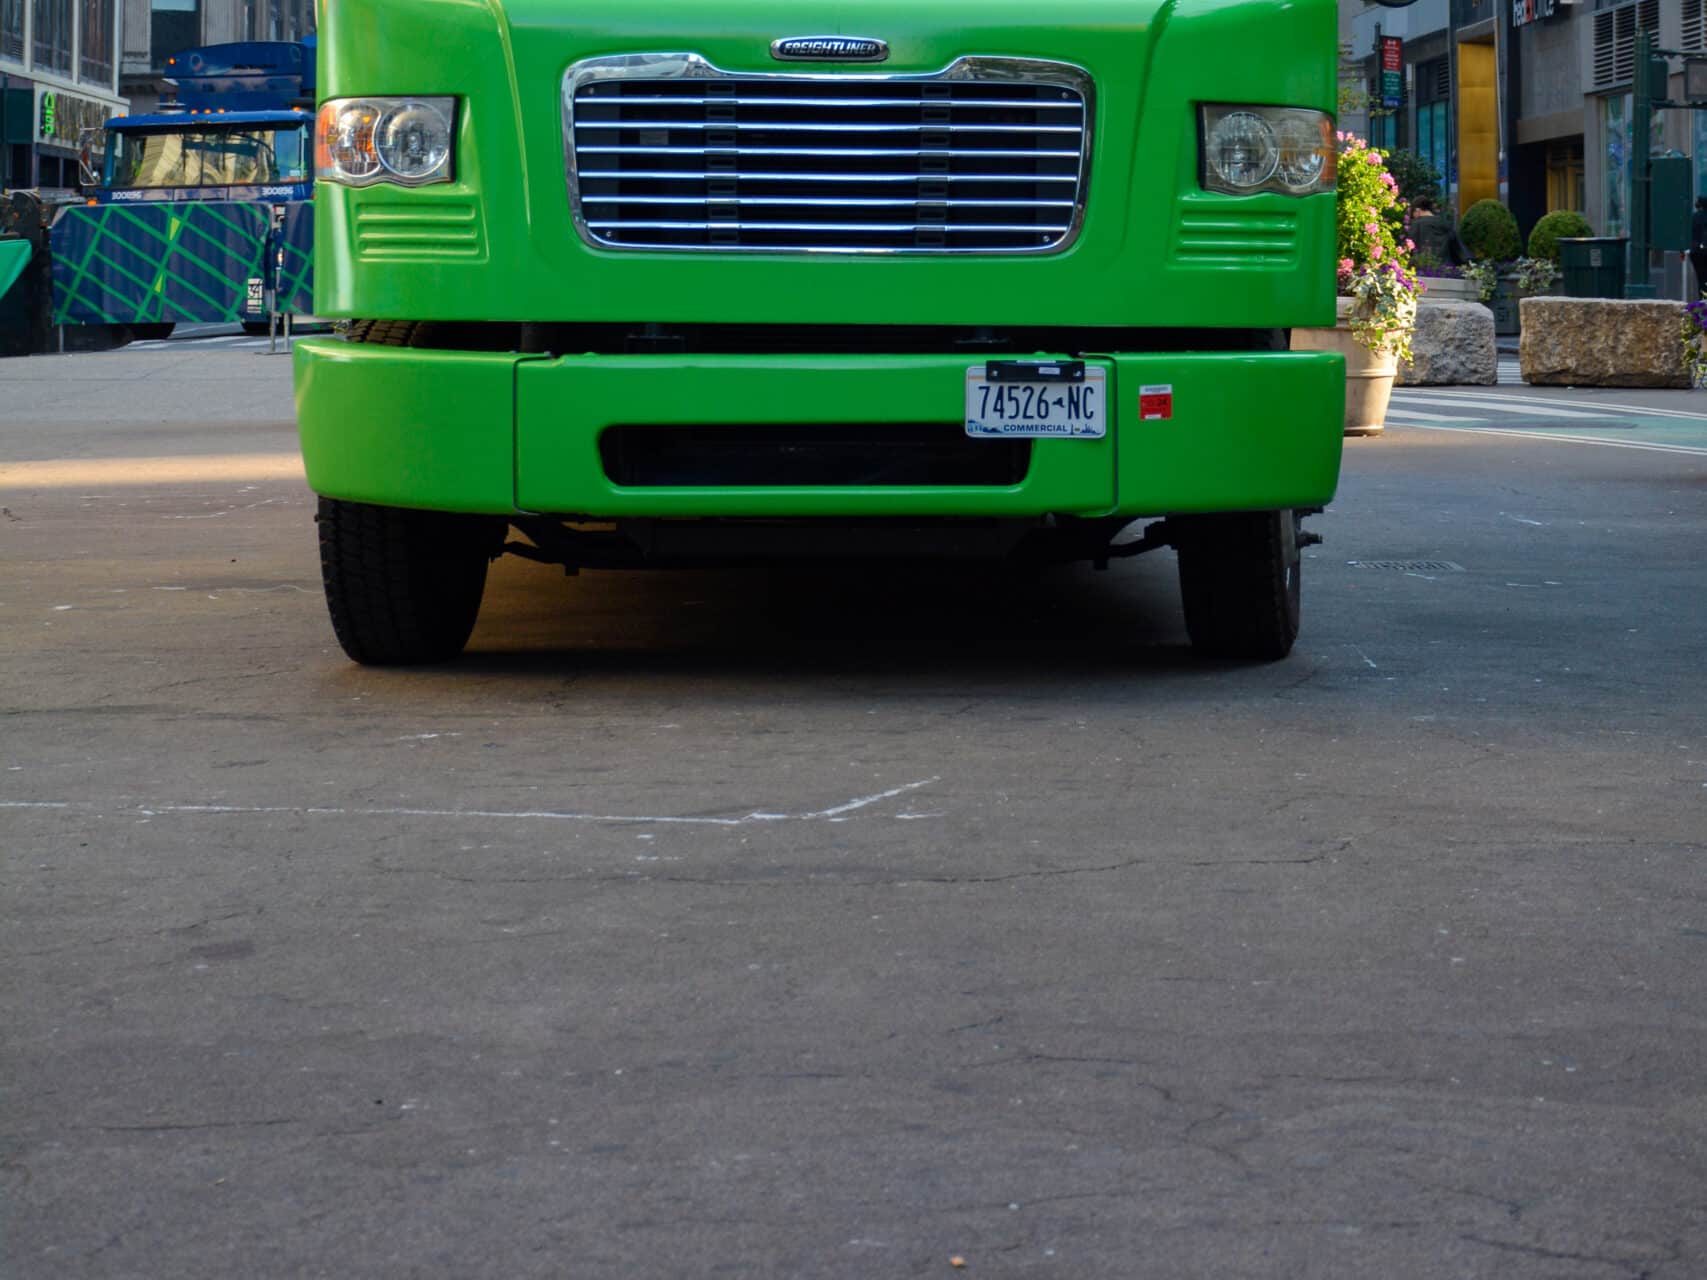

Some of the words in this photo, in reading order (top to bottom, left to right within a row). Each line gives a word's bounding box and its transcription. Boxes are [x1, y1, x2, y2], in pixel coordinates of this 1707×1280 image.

[783, 41, 876, 56] FREIGHTLINER
[978, 385, 1049, 420] 74526
[1067, 385, 1095, 420] NC
[1003, 424, 1068, 433] COMMERCIAL
